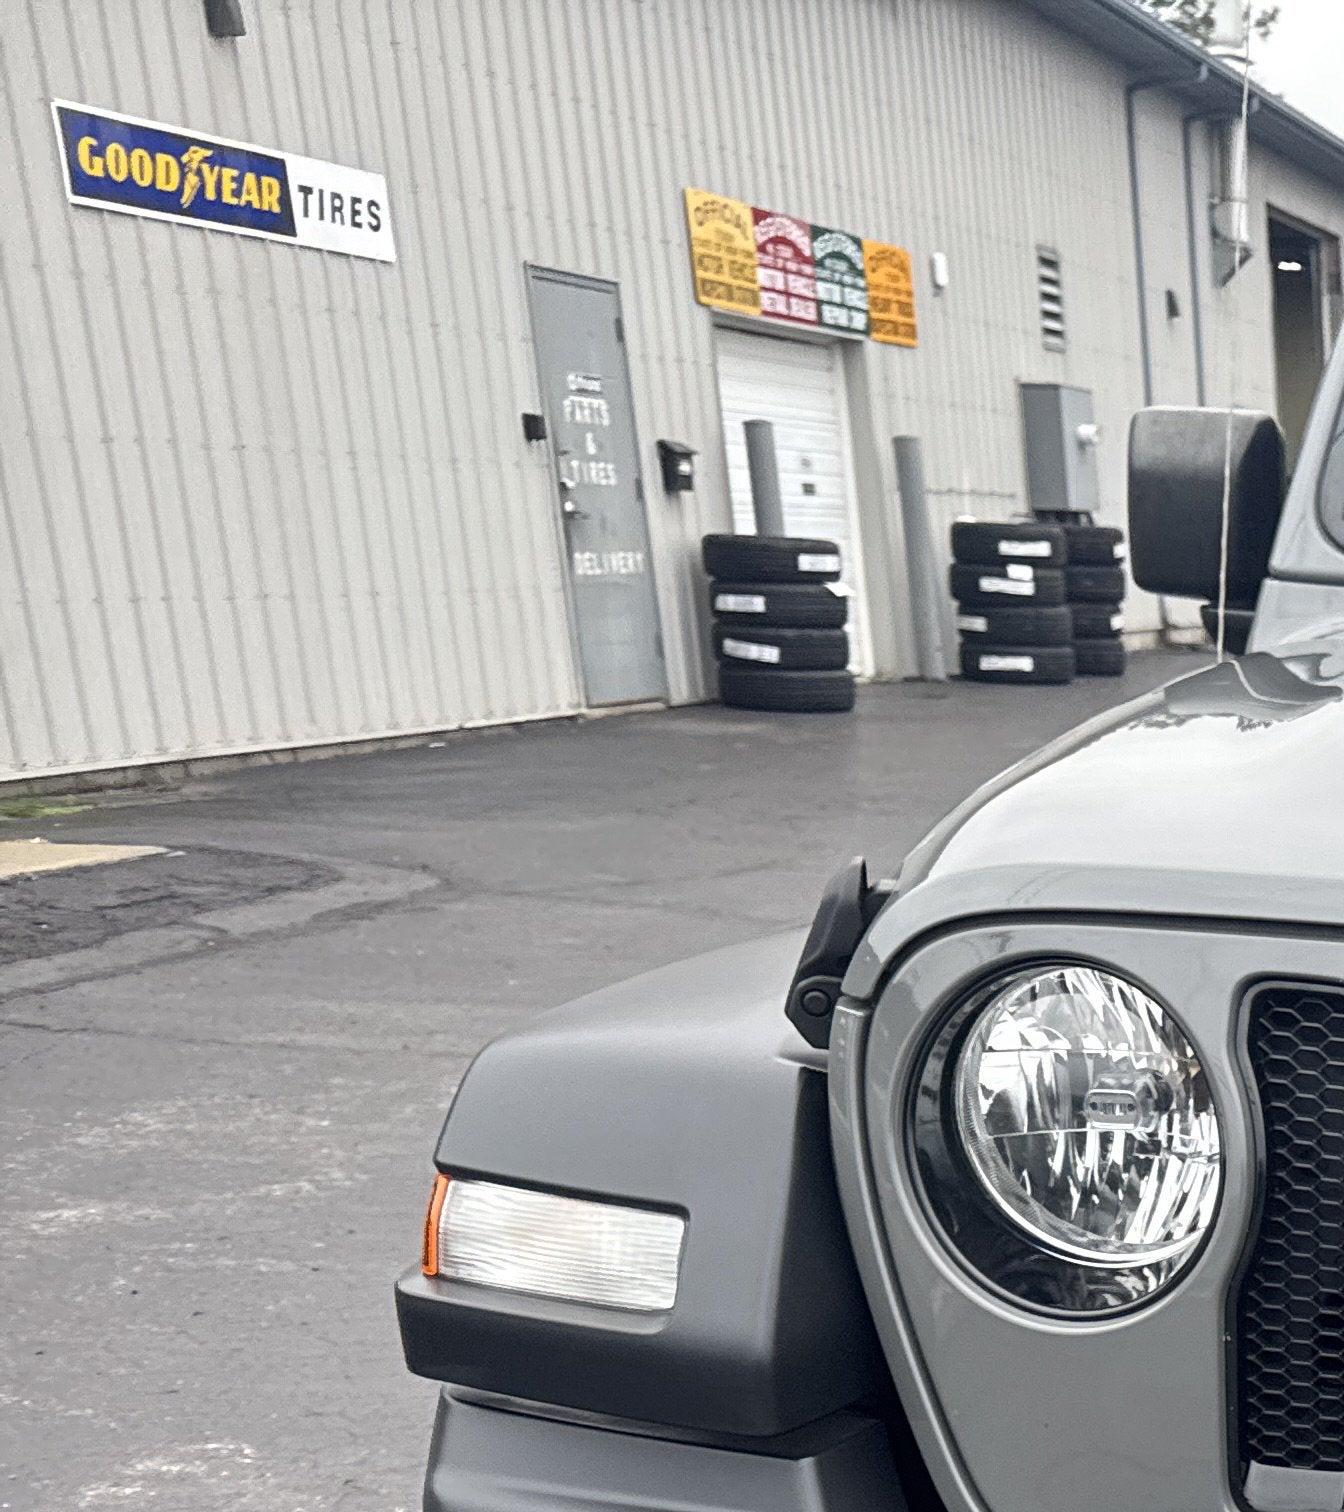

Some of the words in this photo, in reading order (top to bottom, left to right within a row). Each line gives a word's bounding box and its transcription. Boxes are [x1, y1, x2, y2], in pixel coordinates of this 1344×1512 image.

[78, 136, 281, 213] GOODYEAR
[297, 184, 382, 232] TIRES
[563, 398, 609, 426] PARTS
[570, 460, 617, 486] TIRES
[574, 551, 643, 575] DELIVERY
